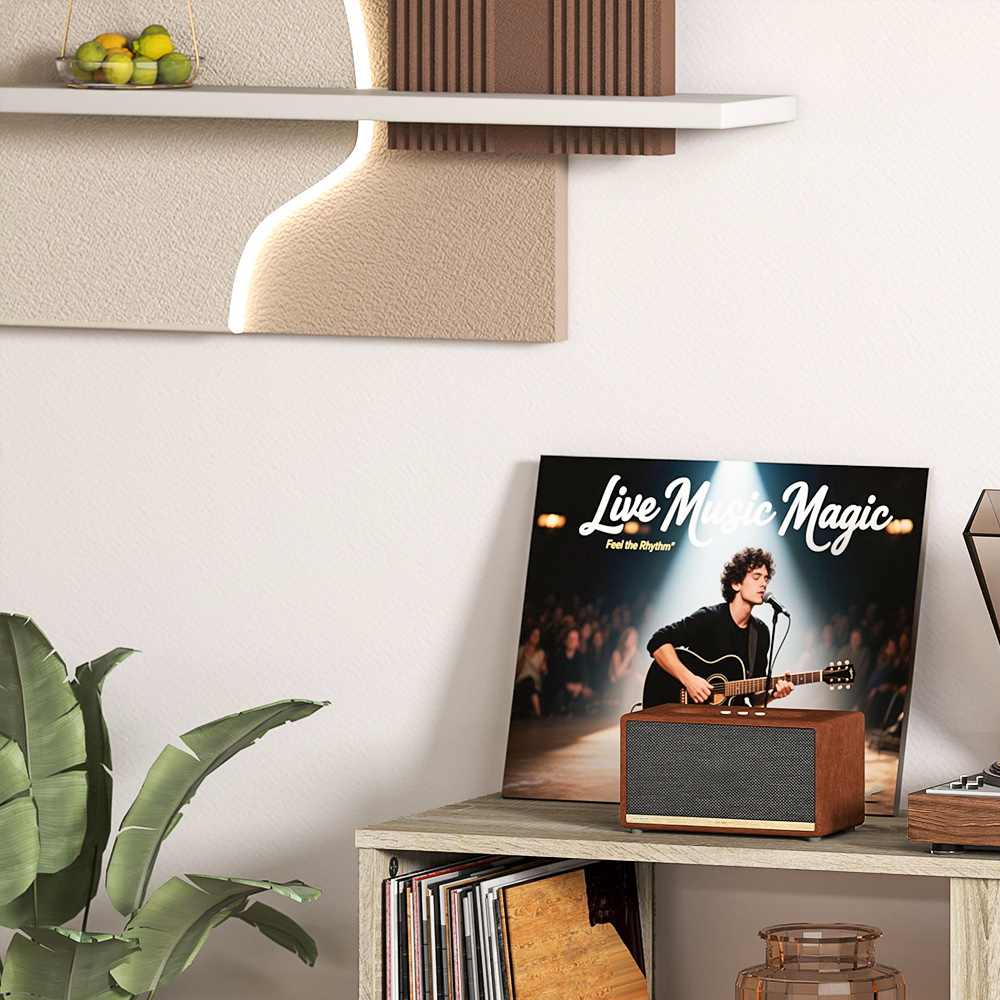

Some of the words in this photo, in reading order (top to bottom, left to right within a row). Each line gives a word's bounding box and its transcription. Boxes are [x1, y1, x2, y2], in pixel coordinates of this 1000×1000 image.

[579, 474, 661, 536] Live
[660, 476, 777, 547] Music
[777, 480, 893, 556] Magic
[605, 538, 625, 550] Feel
[624, 540, 638, 551] the
